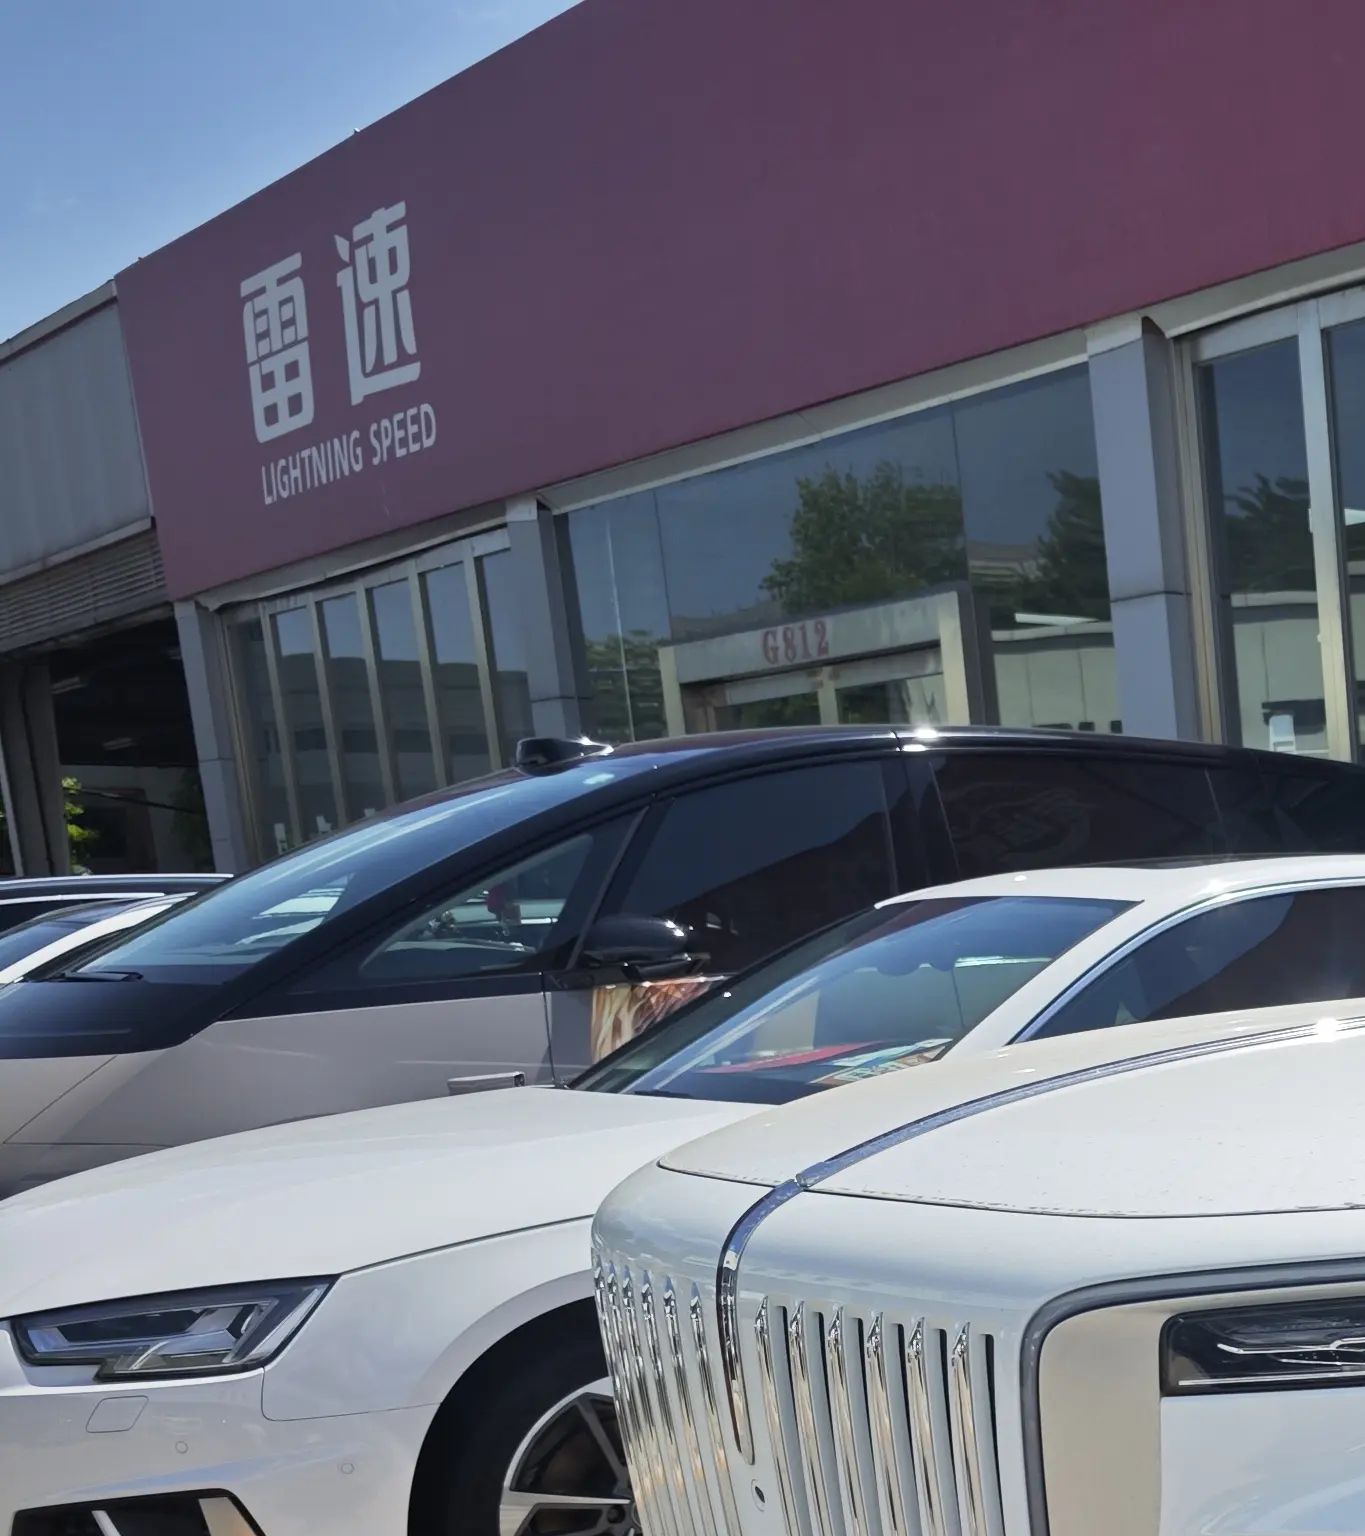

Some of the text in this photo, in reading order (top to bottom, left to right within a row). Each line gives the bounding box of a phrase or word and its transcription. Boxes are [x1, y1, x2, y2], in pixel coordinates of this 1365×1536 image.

[239, 200, 422, 445] 雷速
[261, 403, 437, 506] LIGHTNING SPEED
[762, 618, 830, 665] G812
